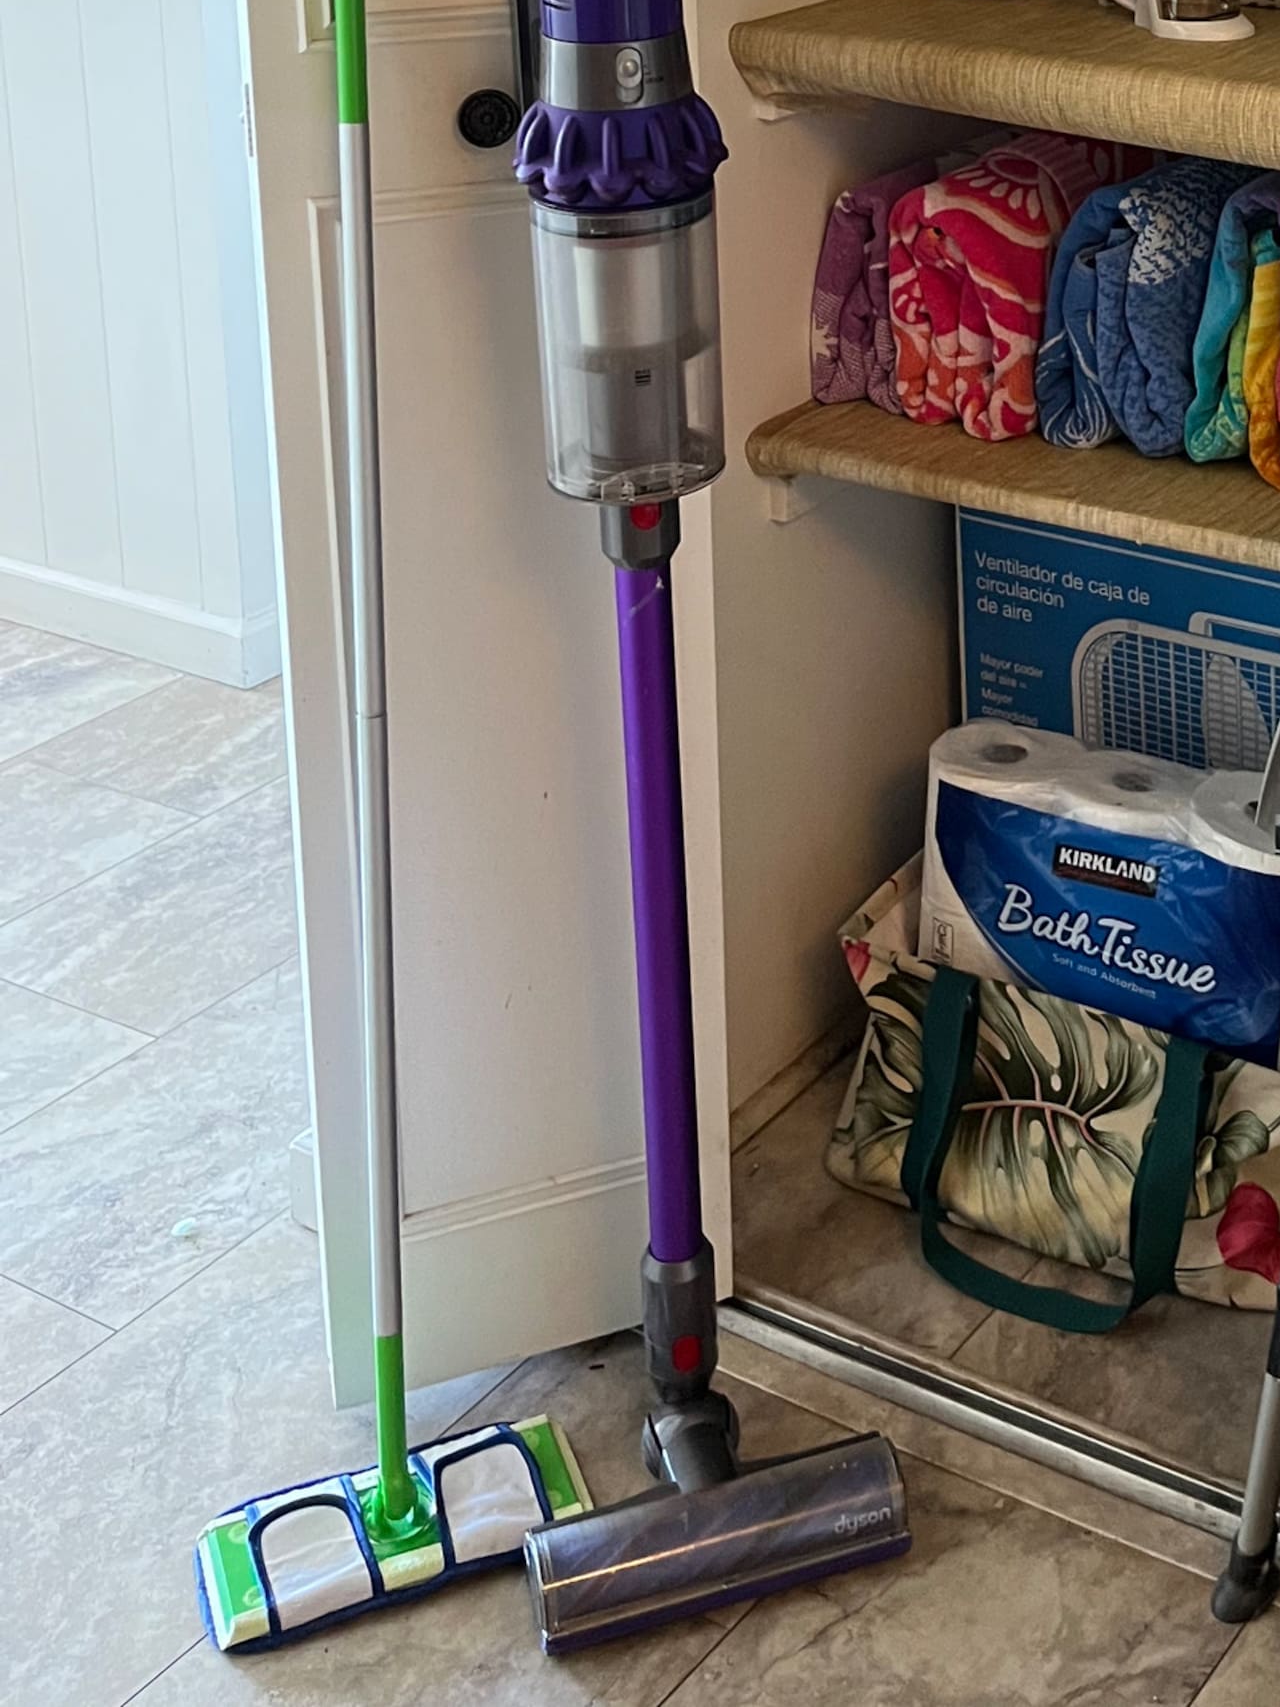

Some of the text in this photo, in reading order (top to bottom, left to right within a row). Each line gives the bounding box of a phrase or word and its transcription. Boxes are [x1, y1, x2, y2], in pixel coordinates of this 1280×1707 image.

[974, 550, 1150, 606] Ventilador de caja de
[976, 574, 1065, 609] circulación
[976, 595, 1033, 622] de aire
[979, 653, 1012, 671] Mayor
[981, 687, 1013, 704] Mayor
[1058, 846, 1156, 883] KIRKLAND
[998, 883, 1217, 993] Bath Tissue
[1052, 954, 1157, 999] Soft and Absorbent
[834, 1506, 892, 1534] dyson
